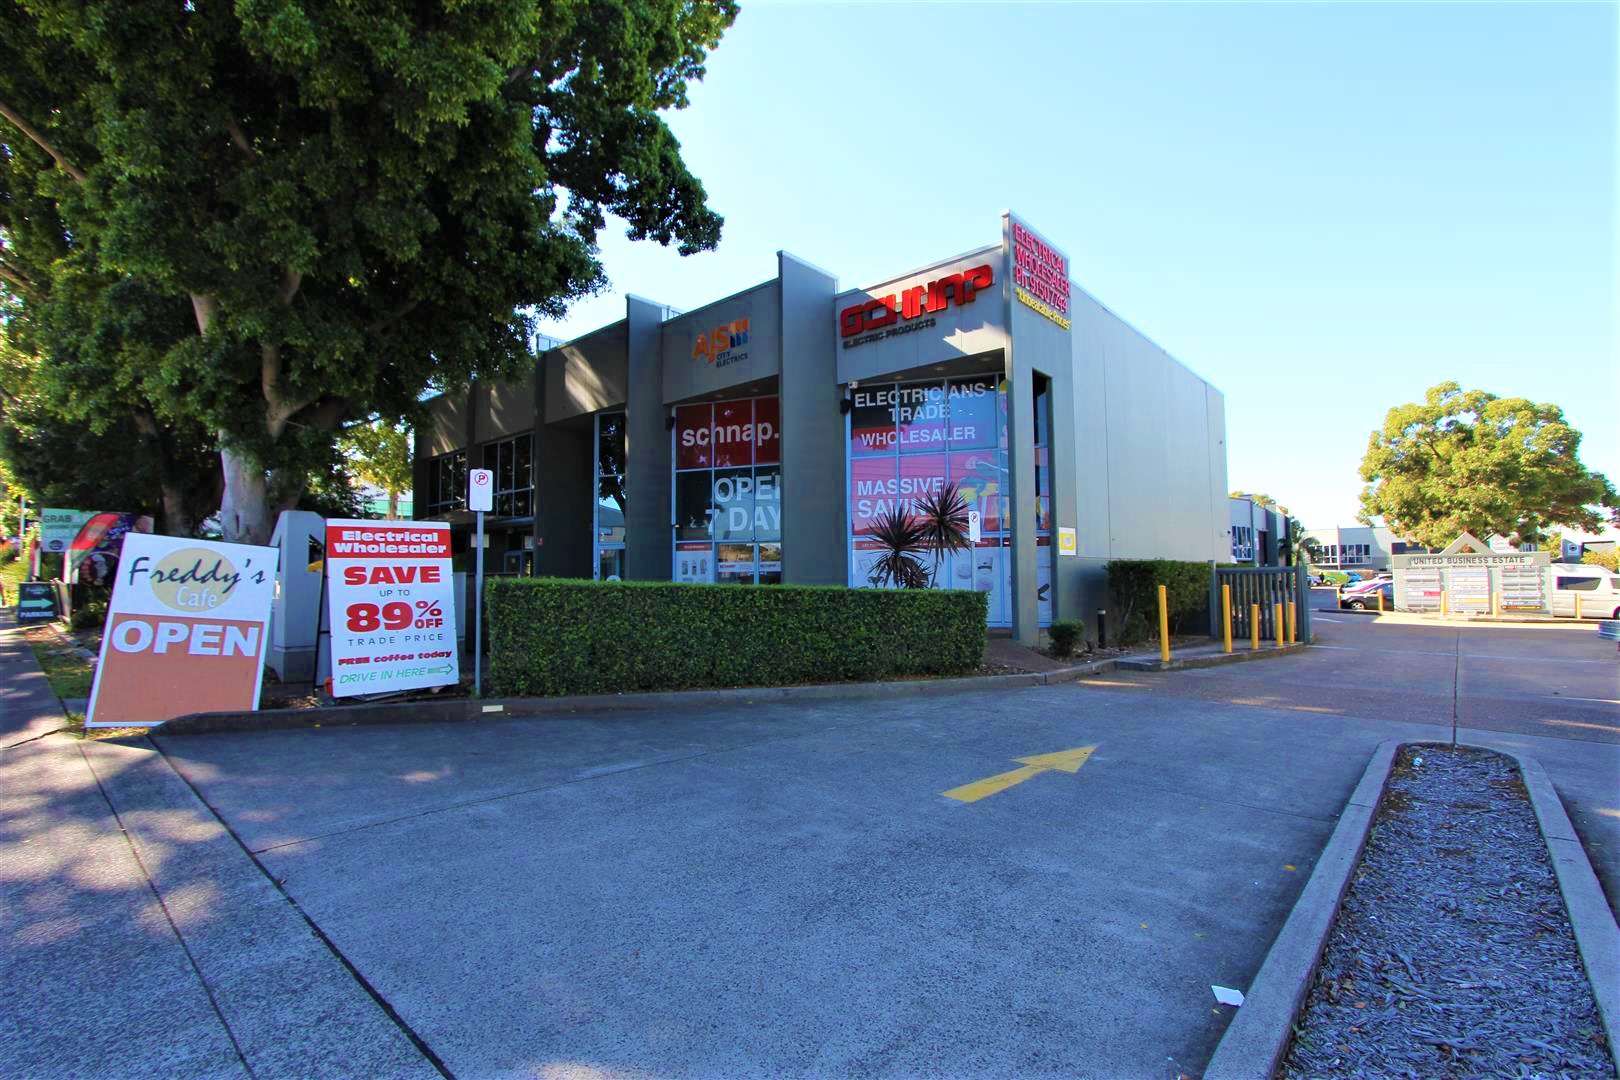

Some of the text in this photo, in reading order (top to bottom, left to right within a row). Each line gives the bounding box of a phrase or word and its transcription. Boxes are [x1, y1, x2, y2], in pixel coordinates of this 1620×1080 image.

[1014, 244, 1070, 297] WHOLESALER
[843, 318, 937, 349] ELECTRIC PRODUCTS
[854, 382, 987, 408] ELECTRICIANS
[888, 403, 951, 423] TRADE
[861, 426, 976, 446] WHOLESALER
[857, 476, 945, 496] MASSIVE
[341, 530, 439, 542] Electrical
[334, 542, 447, 554] Wholesaler
[1413, 555, 1526, 565] UNITED BUSINESS ESTATE
[129, 556, 266, 594] Freddy's
[343, 565, 441, 586] SAVE
[176, 585, 217, 608] Cafe
[379, 588, 410, 598] UP TO
[414, 618, 443, 630] OFF
[111, 619, 259, 657] OPEN
[348, 633, 444, 647] TRADE PRICE
[374, 653, 415, 663] coffee
[418, 650, 453, 659] today
[381, 670, 394, 680] IN
[396, 667, 427, 678] HERE
